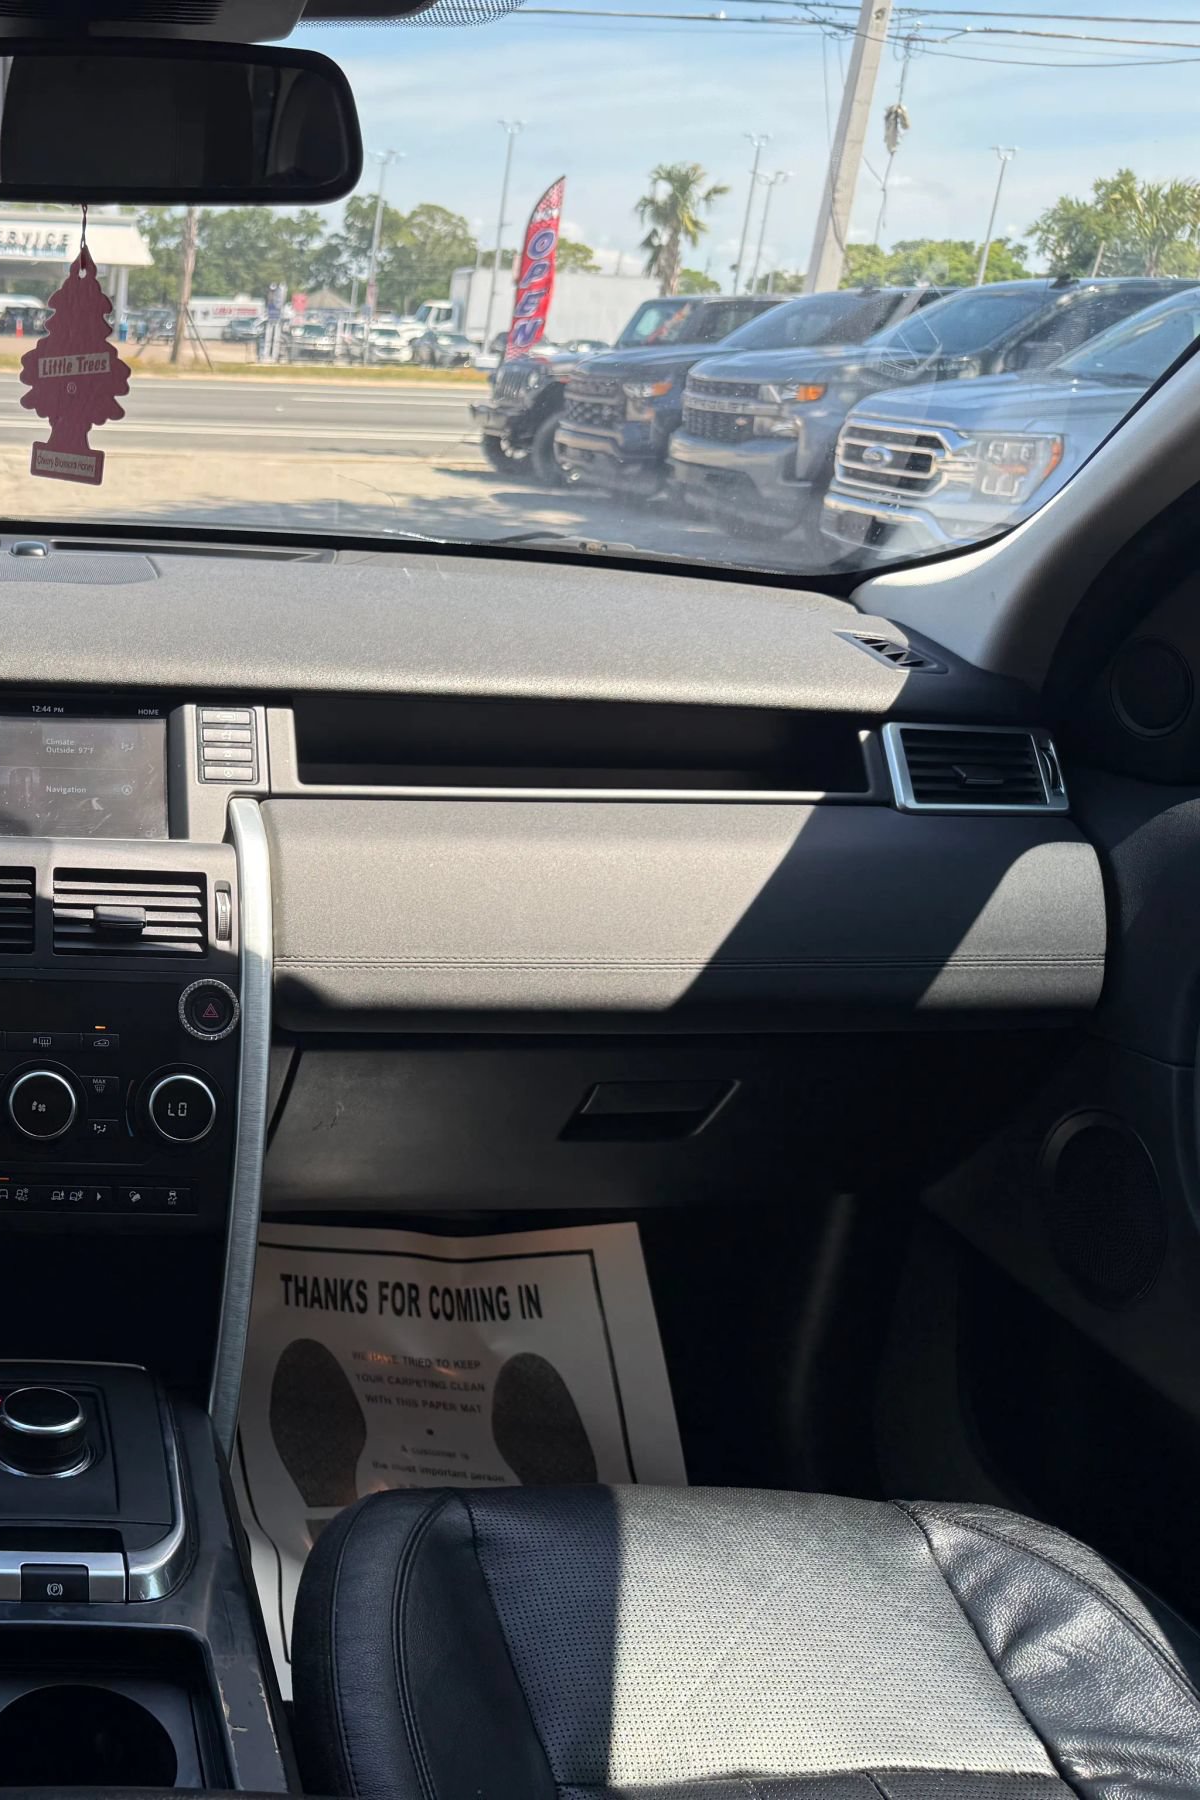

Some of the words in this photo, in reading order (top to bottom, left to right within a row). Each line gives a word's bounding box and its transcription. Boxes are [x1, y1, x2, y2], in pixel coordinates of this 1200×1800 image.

[513, 228, 557, 347] OPEN
[43, 358, 72, 376] Little
[76, 356, 107, 372] Trees
[31, 705, 51, 713] 12:44
[138, 708, 160, 716] HOME
[46, 738, 75, 746] Climate
[46, 785, 87, 794] Navigation
[280, 1273, 369, 1314] THANKS
[378, 1280, 422, 1318] FOR
[429, 1284, 511, 1322] COMING
[518, 1283, 543, 1319] IN
[402, 1356, 433, 1368] TRIED
[436, 1358, 450, 1369] TO
[453, 1360, 481, 1370] KEEP
[355, 1374, 384, 1384] YOUR
[388, 1375, 446, 1390] CARPETING
[449, 1382, 486, 1392] CLEAN
[365, 1394, 392, 1405] WITH
[396, 1397, 419, 1409] THIS
[422, 1400, 457, 1411] PAPER
[460, 1404, 482, 1413] MAT
[372, 1461, 388, 1470] the
[419, 1465, 467, 1479] important
